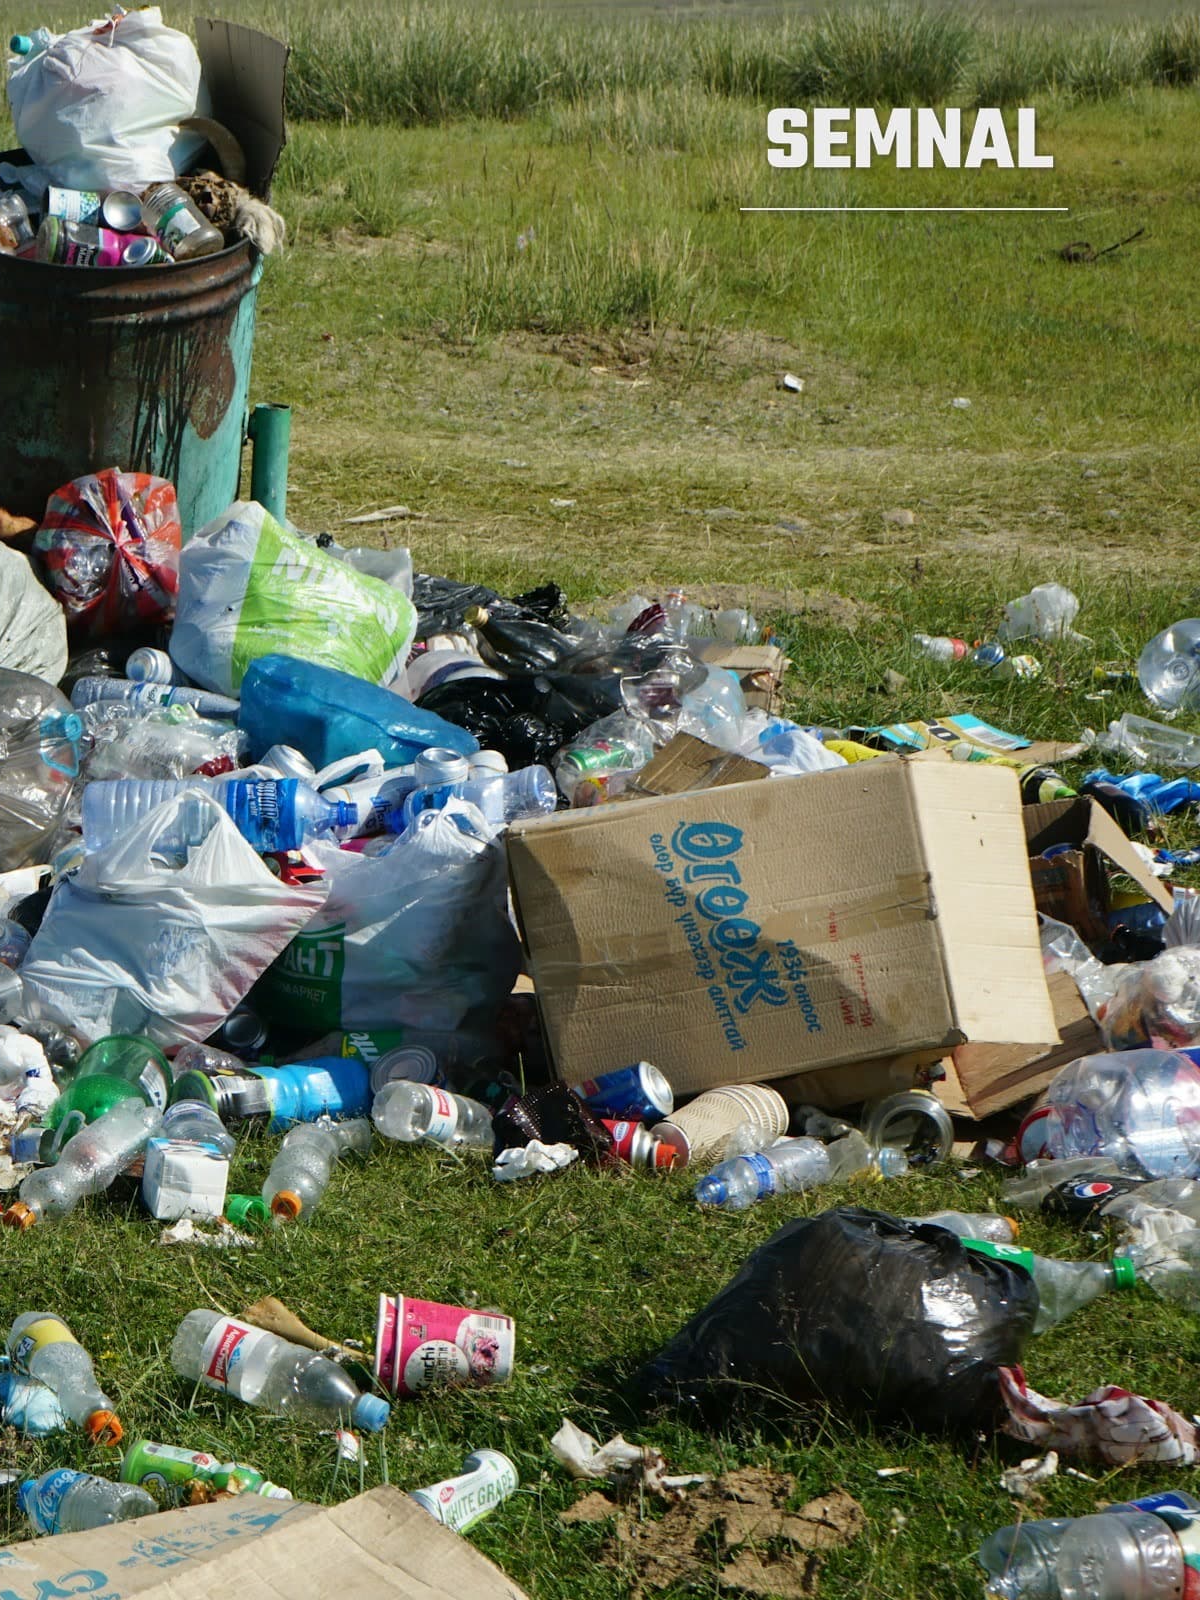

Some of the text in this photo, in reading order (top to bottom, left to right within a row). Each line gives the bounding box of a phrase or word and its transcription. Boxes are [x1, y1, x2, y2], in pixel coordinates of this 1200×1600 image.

[650, 833, 674, 873] өдөр
[707, 984, 747, 1051] амттай
[776, 939, 823, 1033] 1936 оноос
[349, 1031, 381, 1062] rite
[478, 1470, 513, 1506] GRAPE
